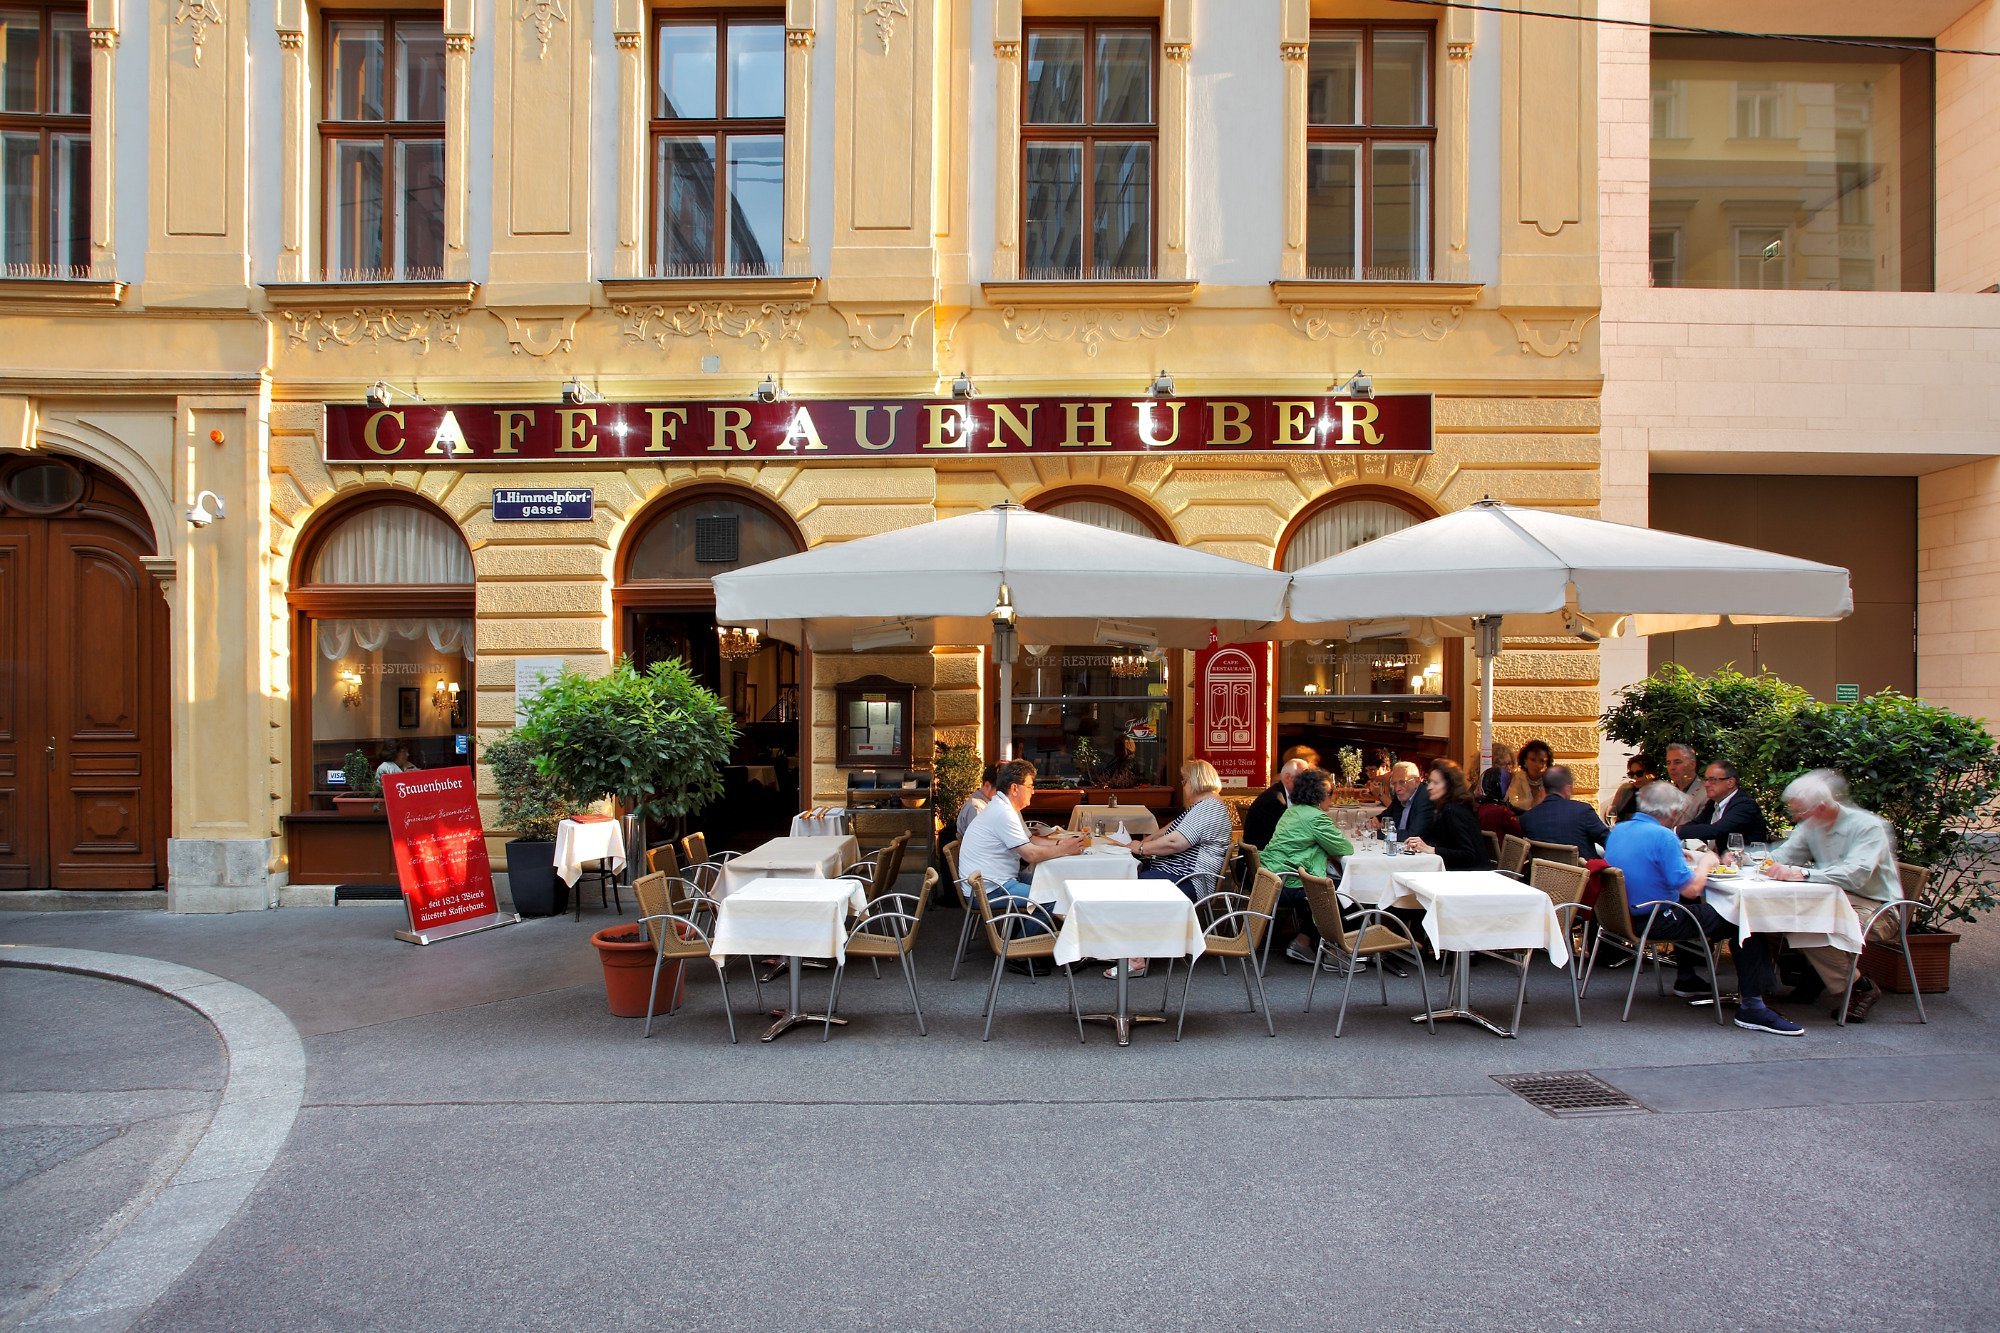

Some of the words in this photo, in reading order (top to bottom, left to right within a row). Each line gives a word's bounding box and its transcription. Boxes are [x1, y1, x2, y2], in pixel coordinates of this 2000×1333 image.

[364, 408, 598, 455] CAFE
[644, 400, 1385, 454] FRAUENHUBER
[522, 505, 563, 517] gasse
[395, 778, 463, 798] Frauenhuber
[428, 899, 441, 909] seit
[442, 895, 460, 906] 1824
[461, 890, 485, 901] Wien's
[421, 910, 447, 922] ältestes
